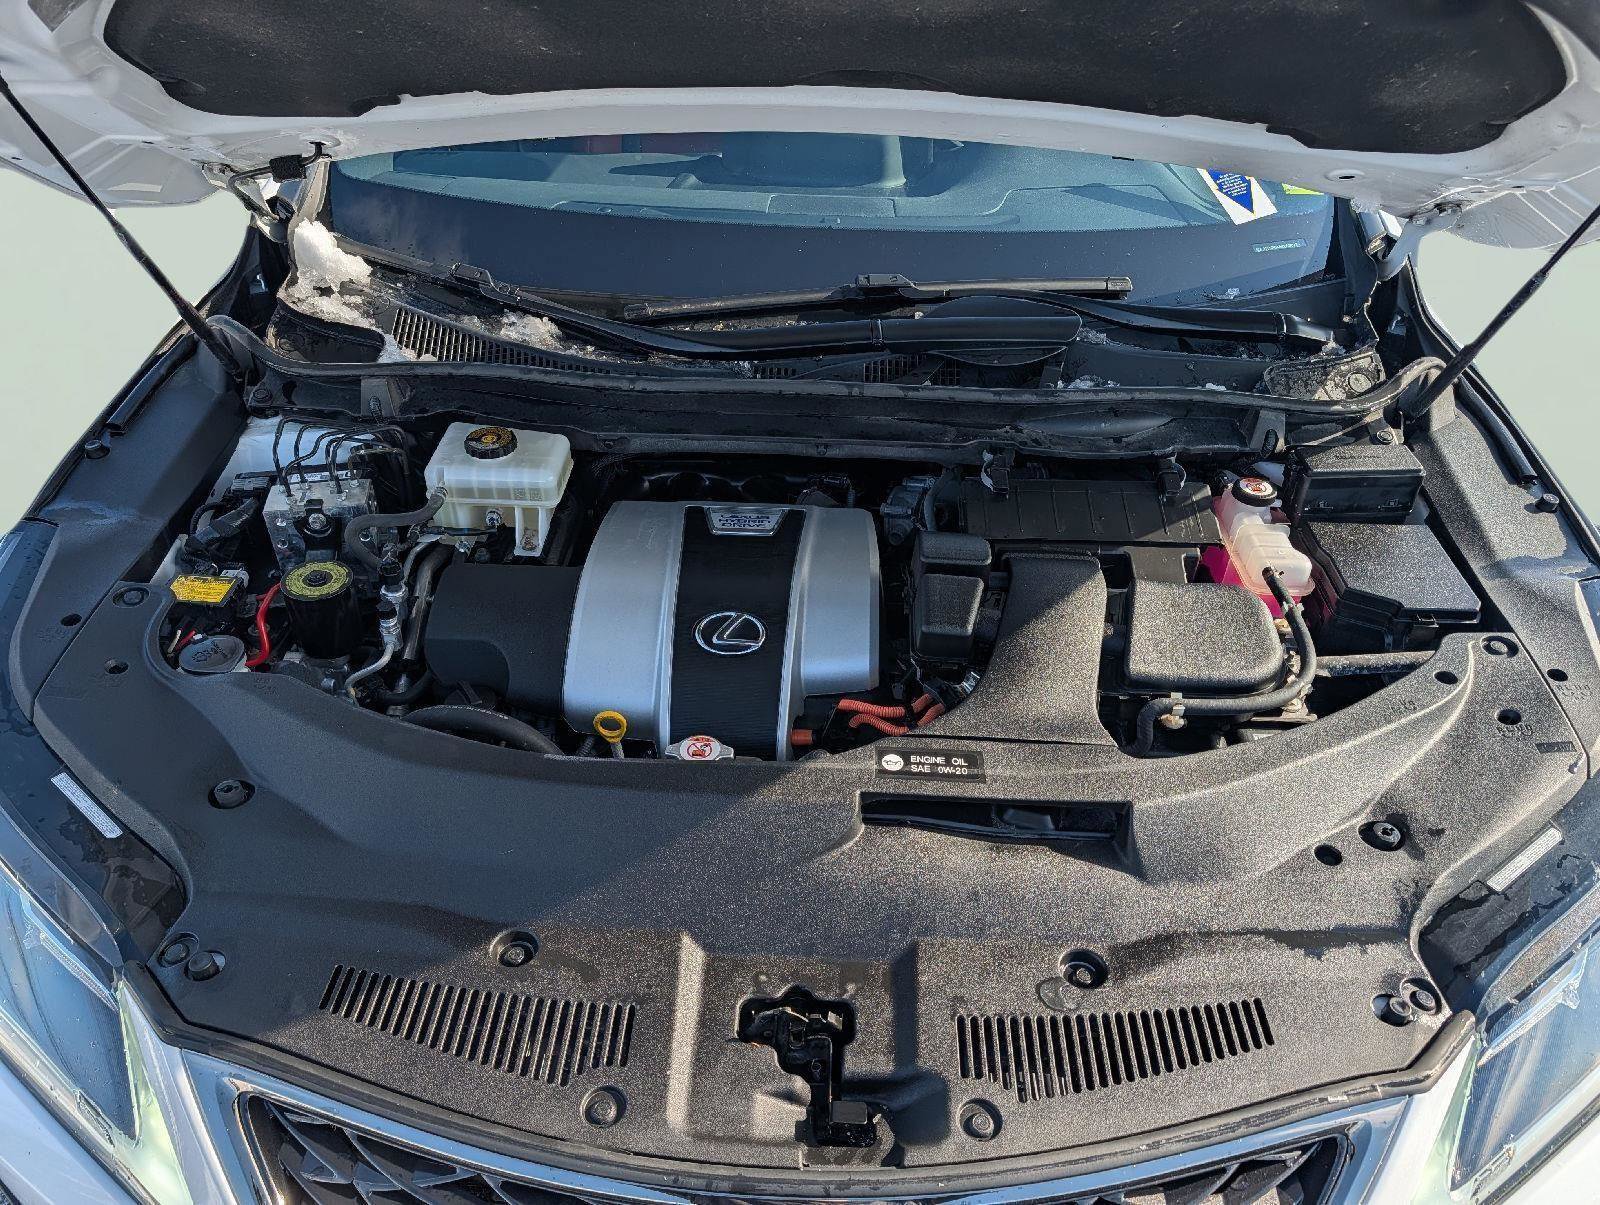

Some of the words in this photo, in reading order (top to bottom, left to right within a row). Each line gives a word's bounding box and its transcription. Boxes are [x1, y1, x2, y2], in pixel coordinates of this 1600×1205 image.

[910, 755, 946, 765] ENGINE
[951, 757, 968, 766] OIL
[910, 764, 931, 773] SAE
[937, 766, 968, 775] 0W-20
